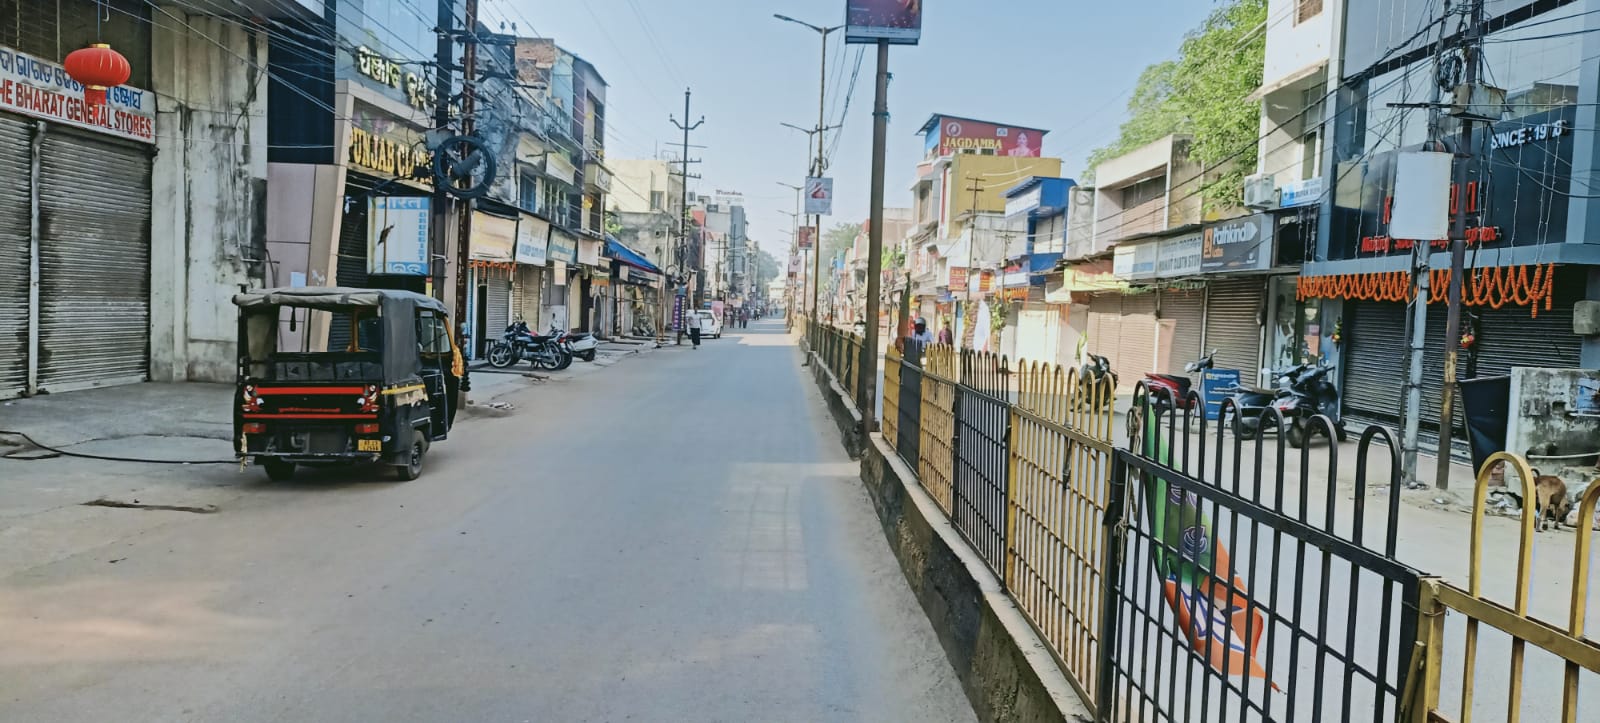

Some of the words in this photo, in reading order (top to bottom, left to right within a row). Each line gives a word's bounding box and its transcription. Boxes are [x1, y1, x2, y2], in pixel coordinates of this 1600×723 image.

[0, 78, 13, 105] HE
[16, 82, 64, 117] BHARAT
[66, 96, 112, 129] GENERAL
[115, 110, 152, 139] STORES
[943, 136, 1003, 149] JAGDAMBA
[1491, 128, 1526, 149] SINCE
[350, 127, 394, 174] PUNJAB
[1213, 222, 1249, 245] Pathkind
